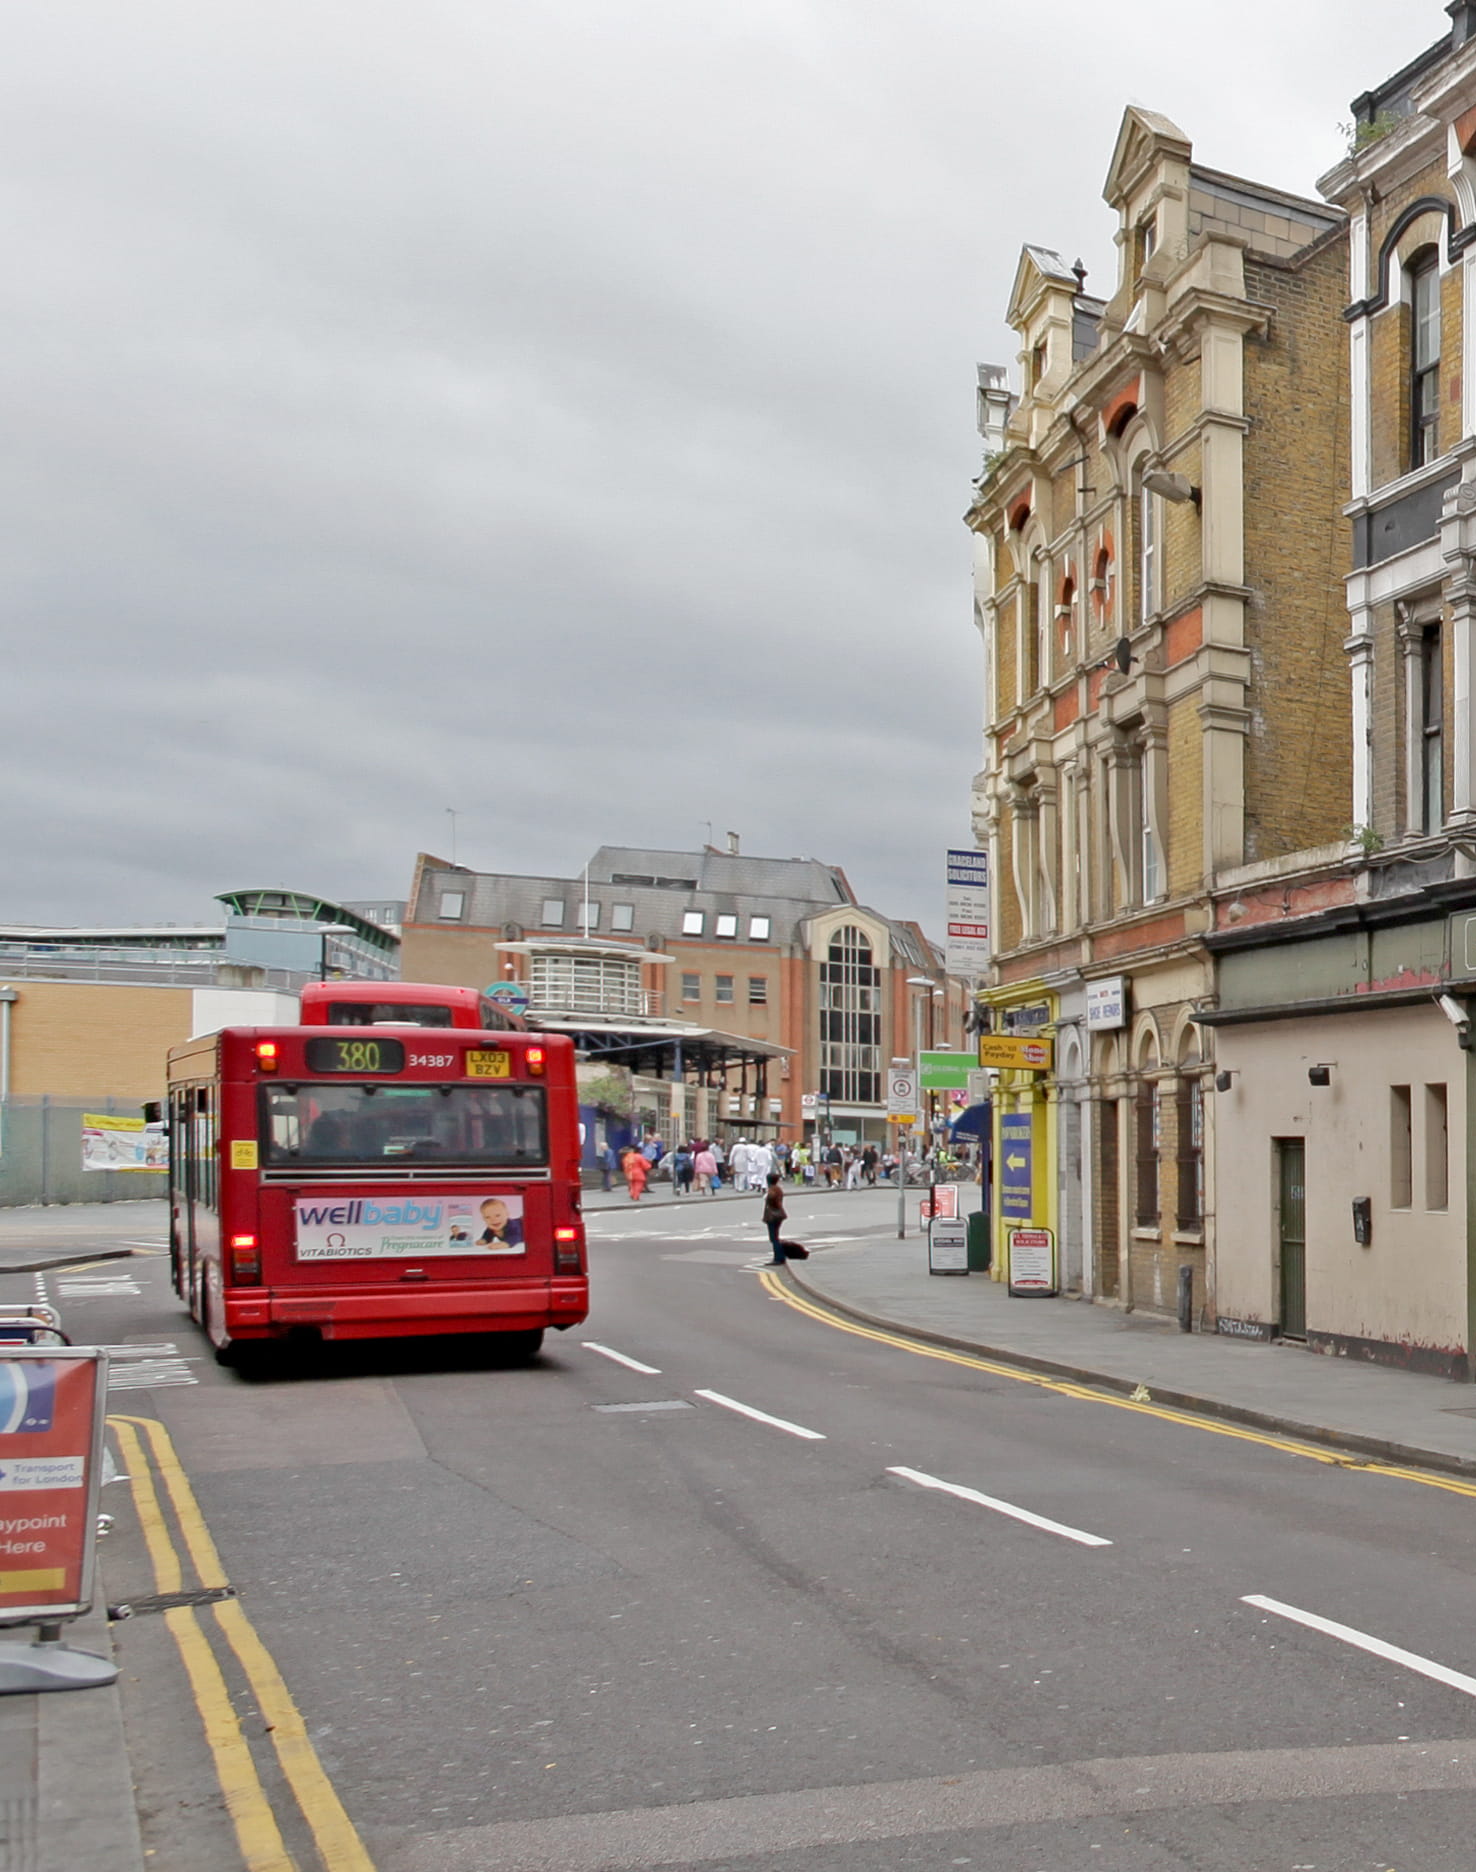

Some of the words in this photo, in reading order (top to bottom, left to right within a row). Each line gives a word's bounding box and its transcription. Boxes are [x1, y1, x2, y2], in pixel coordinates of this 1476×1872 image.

[336, 1042, 380, 1070] 380
[409, 1054, 454, 1067] 34387
[470, 1052, 505, 1064] LX03
[475, 1064, 502, 1075] BZV
[300, 1200, 442, 1231] wellbaby
[300, 1247, 372, 1257] VITABIOTICS
[14, 1463, 75, 1473] Transport
[13, 1476, 31, 1484] for
[35, 1474, 83, 1484] London
[0, 1514, 67, 1535] aypoint
